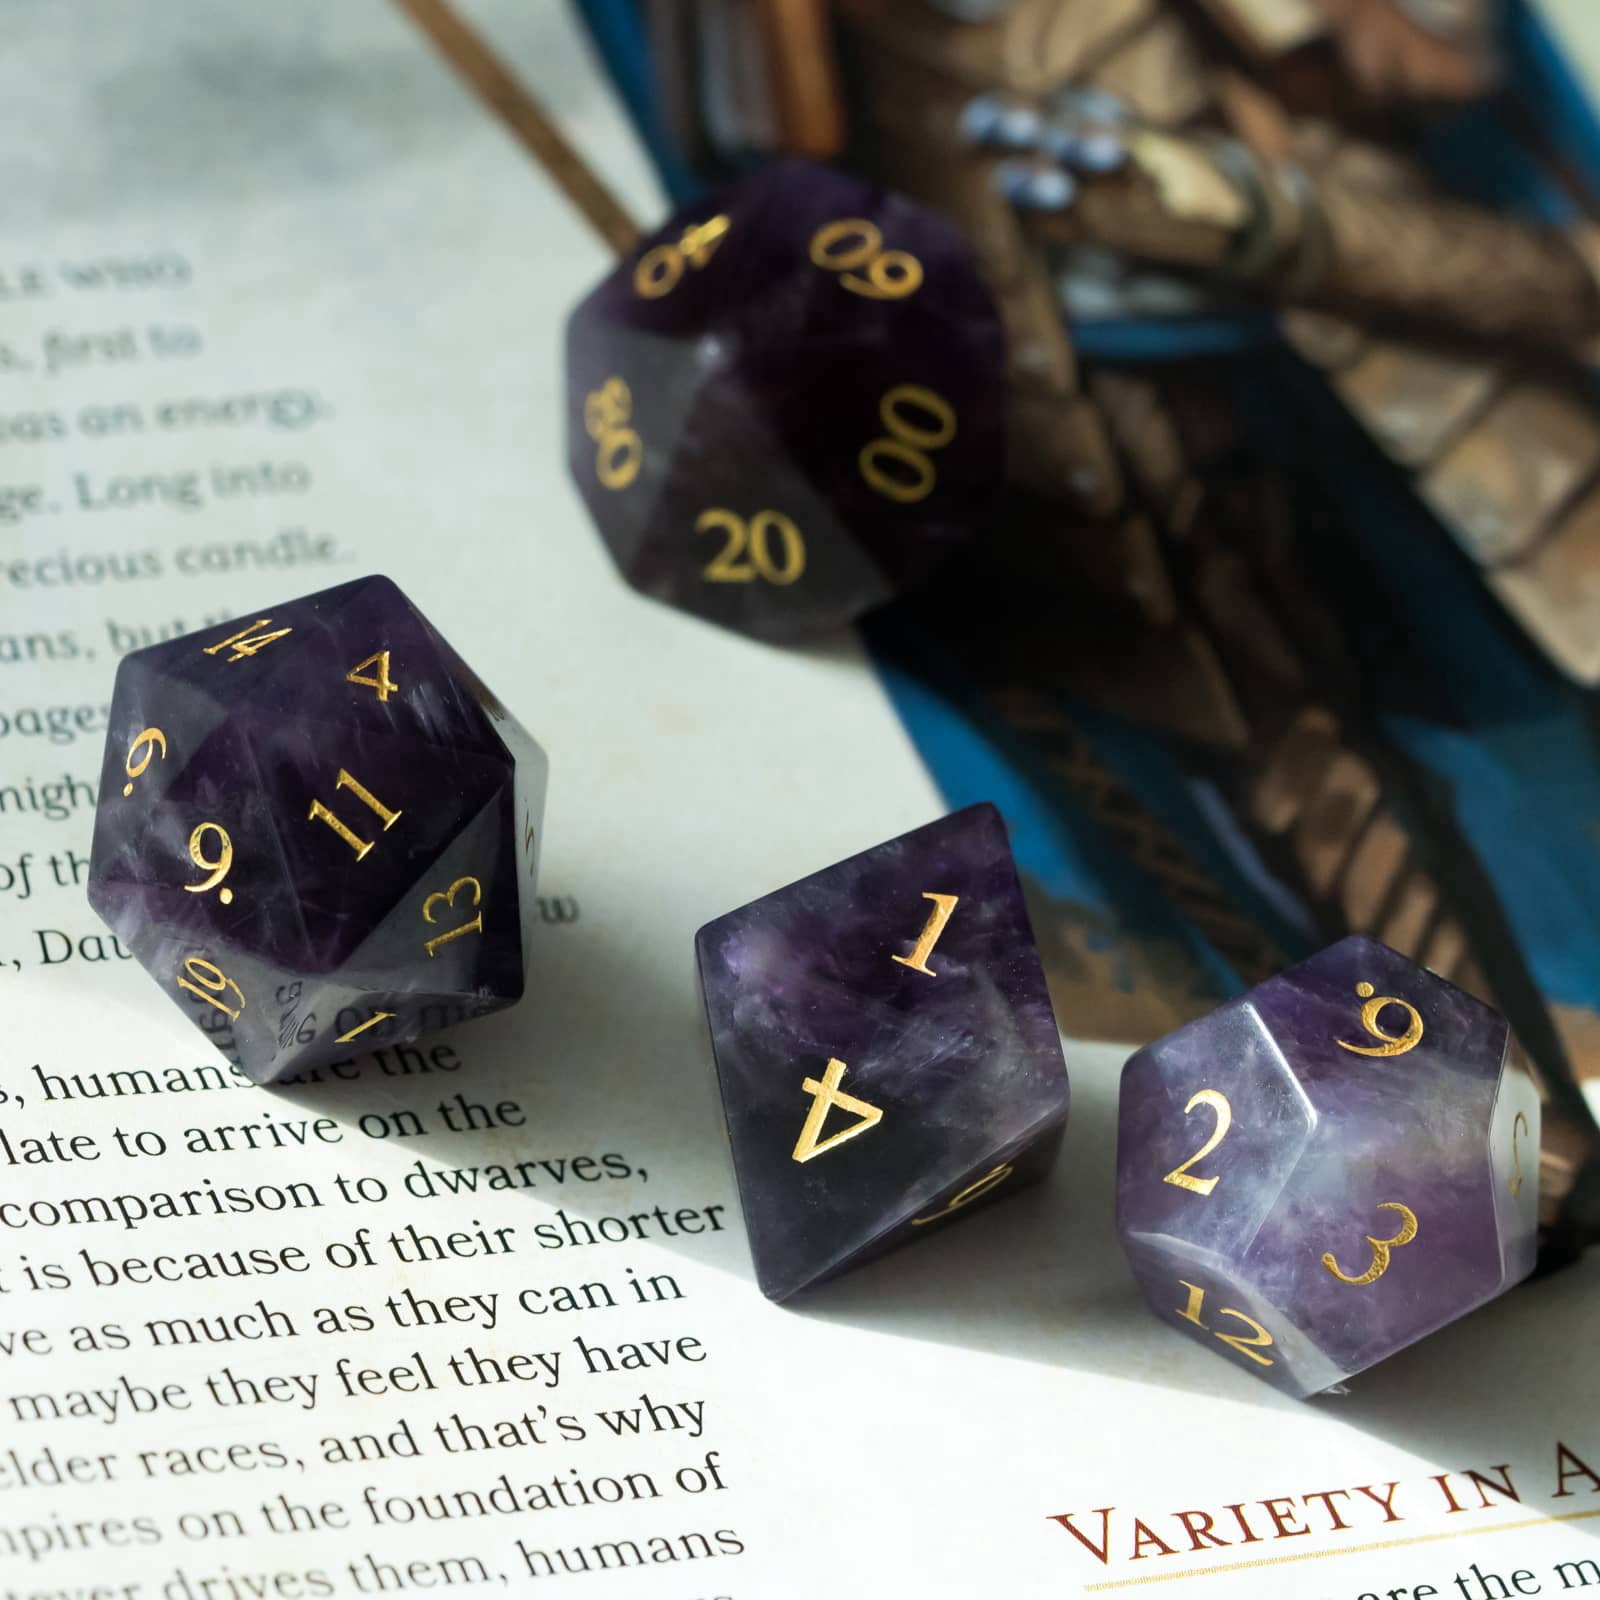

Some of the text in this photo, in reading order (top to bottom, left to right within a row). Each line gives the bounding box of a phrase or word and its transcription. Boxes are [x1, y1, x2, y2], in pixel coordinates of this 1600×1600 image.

[77, 403, 145, 440] an
[858, 385, 958, 503] 00
[72, 472, 204, 513] Long
[211, 461, 313, 497] into
[695, 508, 807, 586] 20
[202, 618, 294, 664] 14
[346, 650, 399, 702] 4
[308, 767, 404, 863] 11
[421, 874, 484, 958] 13
[891, 891, 960, 978] 1
[177, 955, 247, 1023] 19
[334, 1009, 398, 1044] 1
[31, 1057, 258, 1101] humans
[371, 1043, 463, 1078] the
[791, 1057, 884, 1164] 4
[0, 1094, 527, 1165] late to arrive on the
[1162, 1088, 1233, 1197] 2
[0, 1151, 649, 1230] comparison to dwarves,
[20, 1255, 72, 1291] is
[79, 1245, 311, 1287] because
[325, 1229, 378, 1268] of
[387, 1220, 516, 1263] their
[533, 1203, 726, 1250] shorter
[1320, 1201, 1419, 1287] 3
[69, 1322, 131, 1352] as
[145, 1300, 300, 1347] much
[312, 1302, 375, 1335] as
[385, 1287, 499, 1329] they
[518, 1275, 619, 1315] can
[627, 1268, 687, 1304] in
[1174, 1278, 1275, 1368] 12
[8, 1334, 708, 1425] maybe they feel they have
[139, 1440, 305, 1478] races,
[319, 1419, 423, 1464] and
[434, 1405, 588, 1453] that’s
[595, 1394, 706, 1438] why
[178, 1508, 247, 1541] on
[260, 1494, 351, 1534] the
[363, 1468, 664, 1525] foundation
[675, 1451, 729, 1494] of
[1045, 1481, 1405, 1566] VARIETY
[1428, 1464, 1523, 1515] IN
[164, 1565, 336, 1600] drives
[348, 1553, 509, 1592] them,
[514, 1527, 746, 1578] humans
[1453, 1562, 1542, 1600] the
